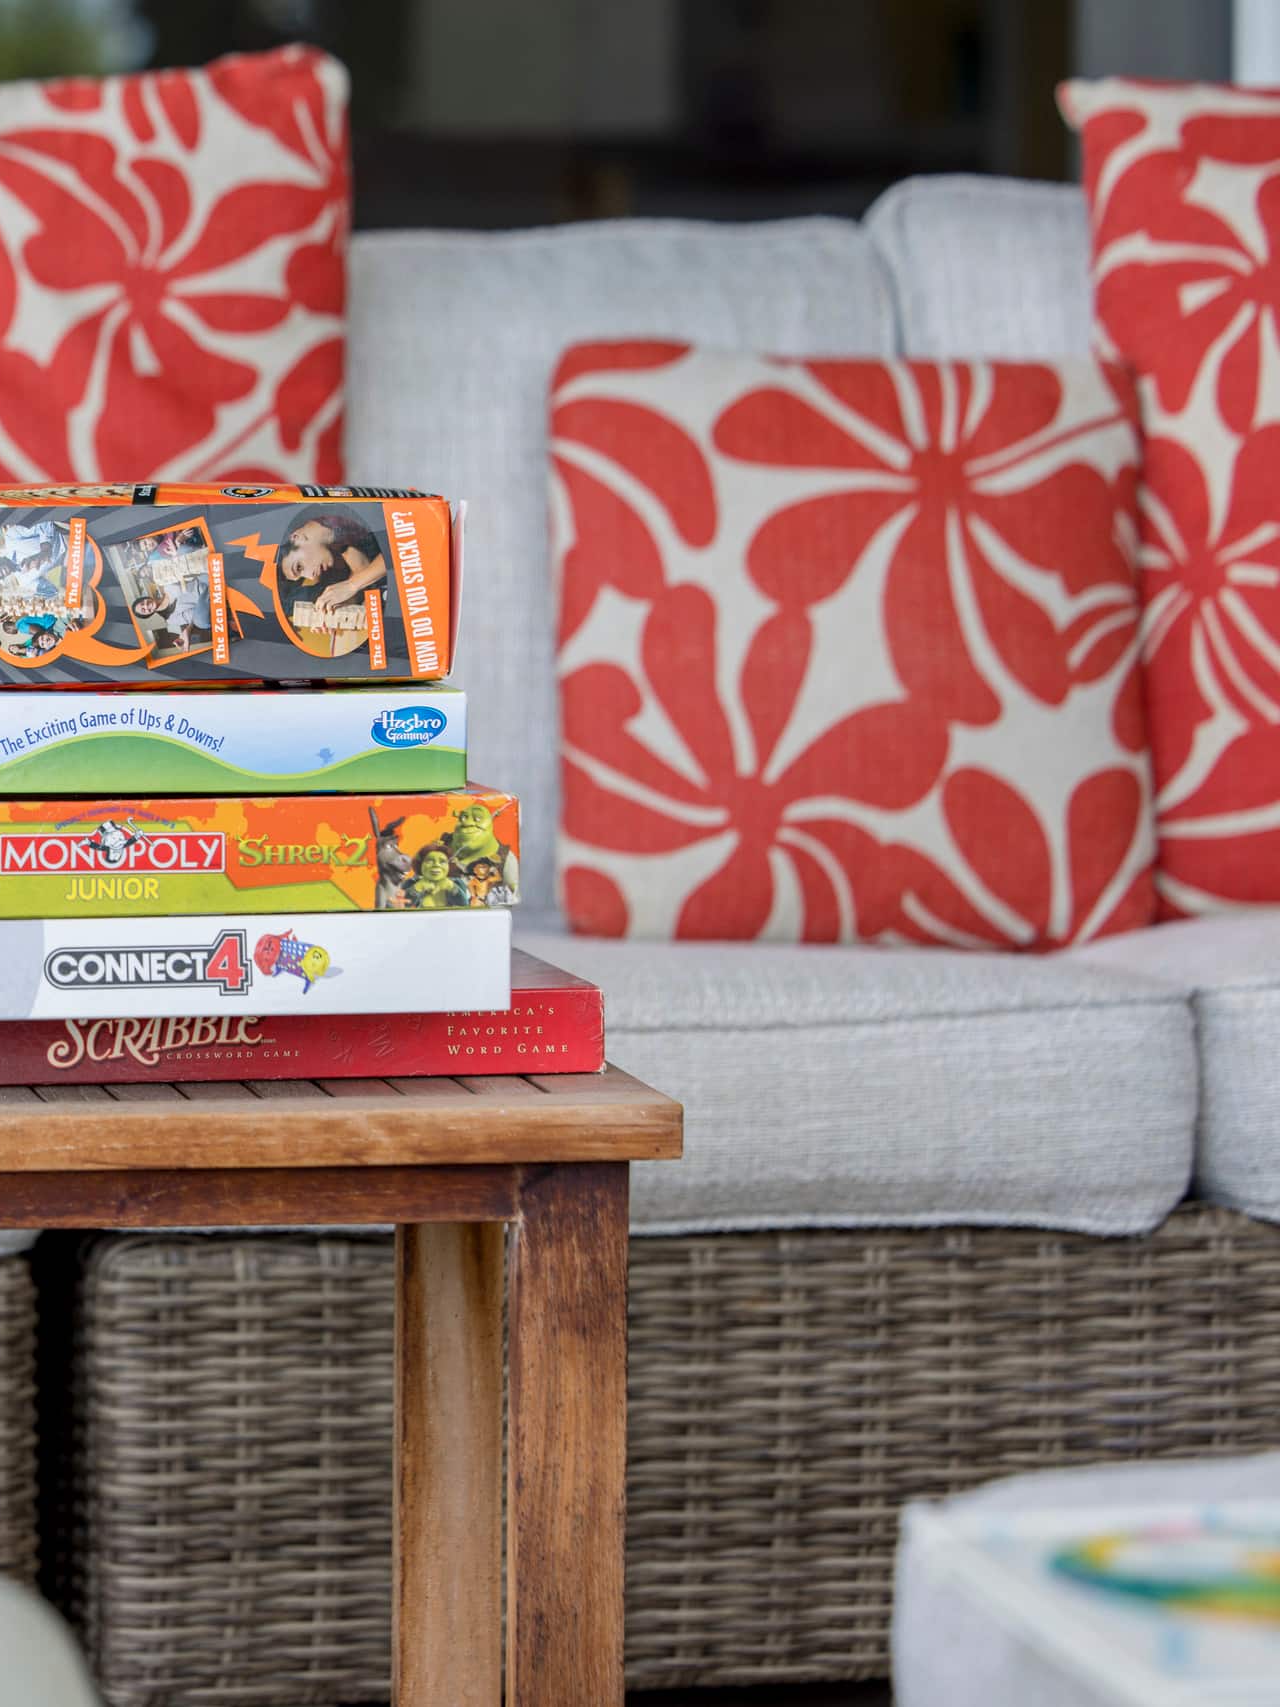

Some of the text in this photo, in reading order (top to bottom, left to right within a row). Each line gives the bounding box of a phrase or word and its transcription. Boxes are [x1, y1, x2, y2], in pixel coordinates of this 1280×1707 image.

[68, 523, 83, 605] The Architect
[212, 558, 226, 661] The Zen Master
[391, 511, 439, 673] HOW DO YOU STACK UP?
[369, 593, 383, 666] The Cheater
[24, 717, 77, 745] Exciting
[79, 711, 117, 729] Game
[120, 708, 135, 725] of
[138, 708, 161, 730] Ups
[164, 714, 176, 731] &
[177, 718, 225, 752] Downs!
[374, 710, 442, 733] Hasbro
[385, 727, 431, 743] Gaming
[3, 837, 221, 869] MONOPOLY
[65, 877, 159, 901] JUNIOR
[51, 935, 245, 989] CONNECT 4
[47, 1015, 263, 1068] SCRABBLE
[447, 1025, 543, 1036] FAVORITE
[447, 1042, 569, 1055] WORD GAME
[166, 1050, 301, 1060] CROSSWORD GAME
